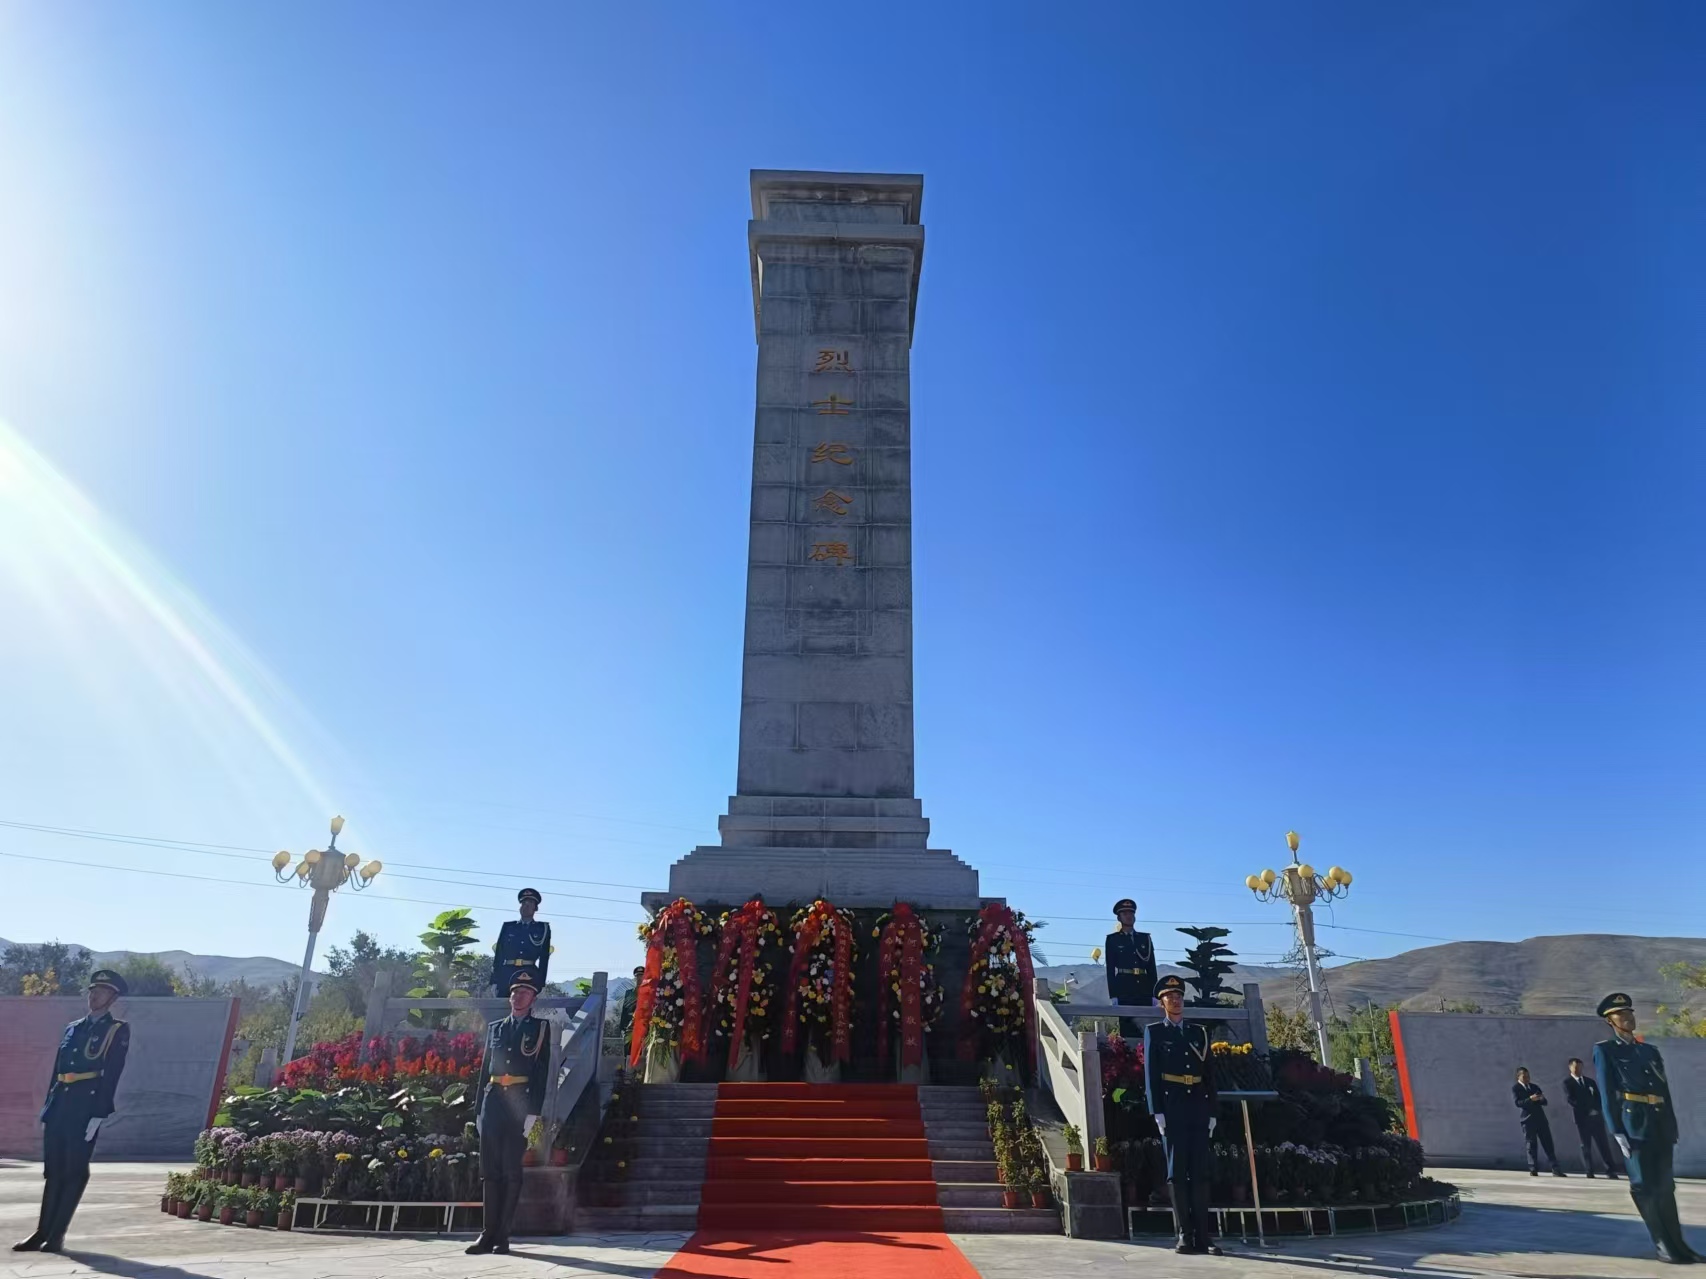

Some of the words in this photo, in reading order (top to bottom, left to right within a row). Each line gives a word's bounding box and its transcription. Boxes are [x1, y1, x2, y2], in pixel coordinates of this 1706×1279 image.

[807, 349, 853, 566] 烈士纪念碑
